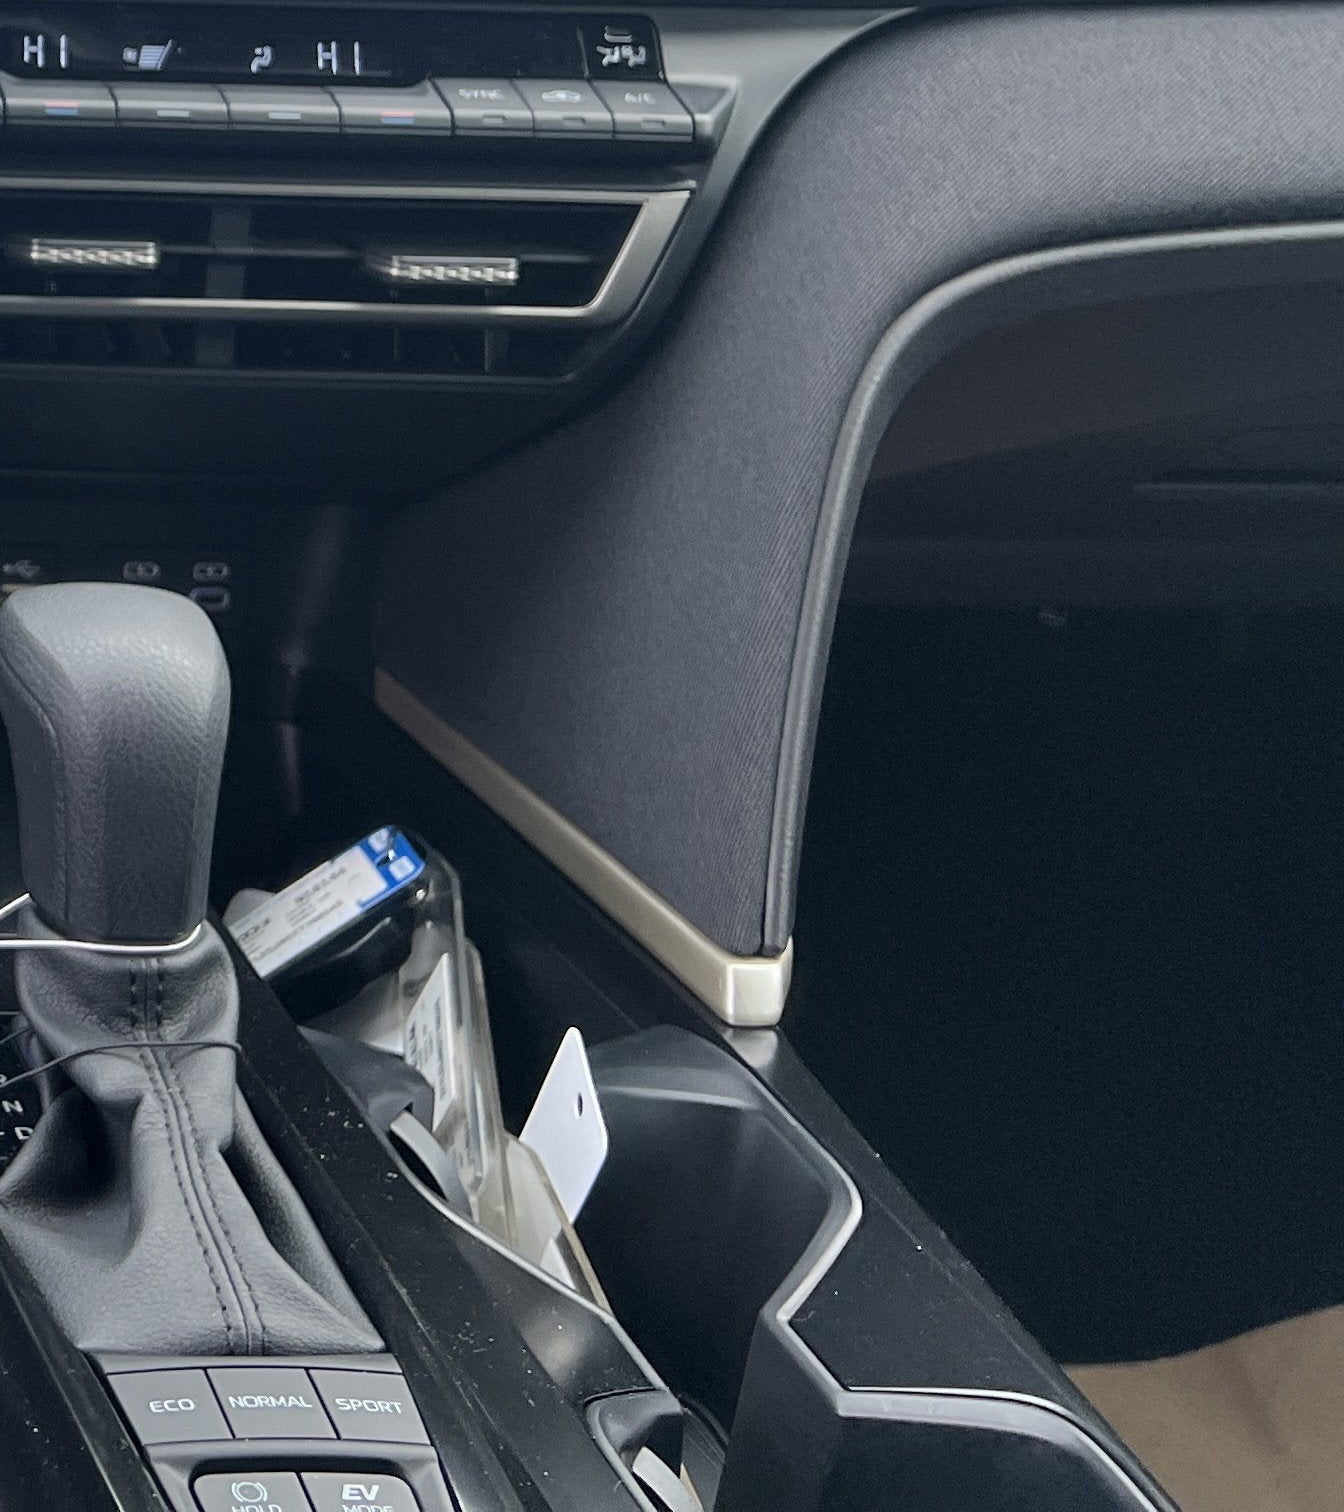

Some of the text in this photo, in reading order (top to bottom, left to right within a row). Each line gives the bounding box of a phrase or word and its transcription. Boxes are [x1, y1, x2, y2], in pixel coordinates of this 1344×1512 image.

[1, 1099, 24, 1113] N
[14, 1126, 34, 1141] D
[149, 1397, 194, 1413] ECO
[228, 1395, 312, 1410] NORMAL
[335, 1397, 403, 1415] SPORT
[341, 1484, 380, 1501] EV
